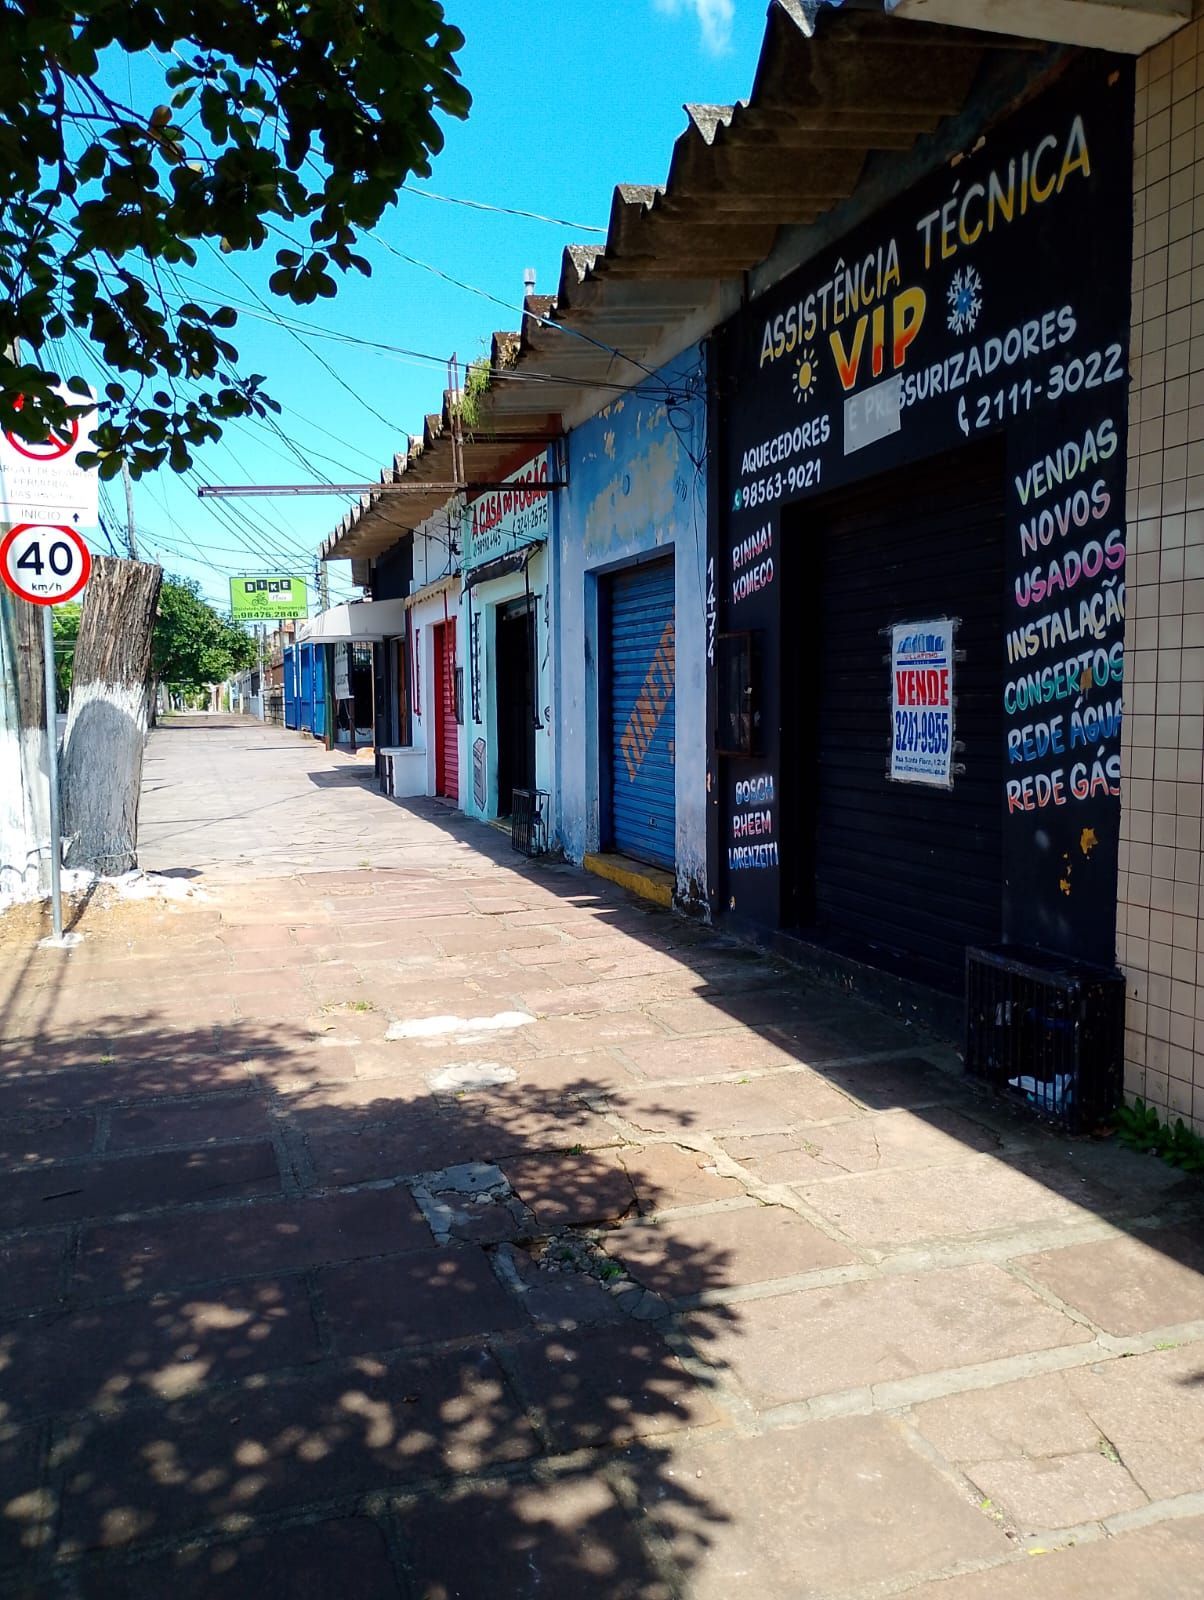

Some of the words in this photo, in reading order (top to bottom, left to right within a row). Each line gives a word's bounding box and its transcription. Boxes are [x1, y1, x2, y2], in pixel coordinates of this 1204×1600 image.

[760, 238, 900, 368] ASSISTÊNCIA
[916, 114, 1091, 269] TÉCNICA
[830, 286, 926, 391] VIP
[976, 343, 1124, 428] 2111-3022
[741, 414, 831, 476] AQUECEDORES
[1015, 418, 1118, 505] VENDAS
[742, 458, 821, 508] 98563-9021
[472, 503, 478, 540] A
[479, 492, 502, 535] CASA
[1019, 479, 1110, 557] NOVOS
[17, 541, 73, 577] 40
[732, 522, 772, 571] RINNAI
[1015, 529, 1125, 607] USADOS
[32, 582, 62, 592] km/h
[246, 581, 290, 592] BIKE
[732, 558, 774, 604] KOMECO
[896, 669, 948, 706] VENDE
[1004, 641, 1123, 715] CONSERTOS
[896, 710, 949, 754] 3241-9955
[1007, 715, 1064, 764] REDE
[735, 775, 773, 804] BOSCH
[1006, 768, 1066, 814] REDE
[1070, 745, 1121, 800] GÁS
[733, 810, 771, 838] RHEEM
[728, 841, 778, 869] LORENZETTI
